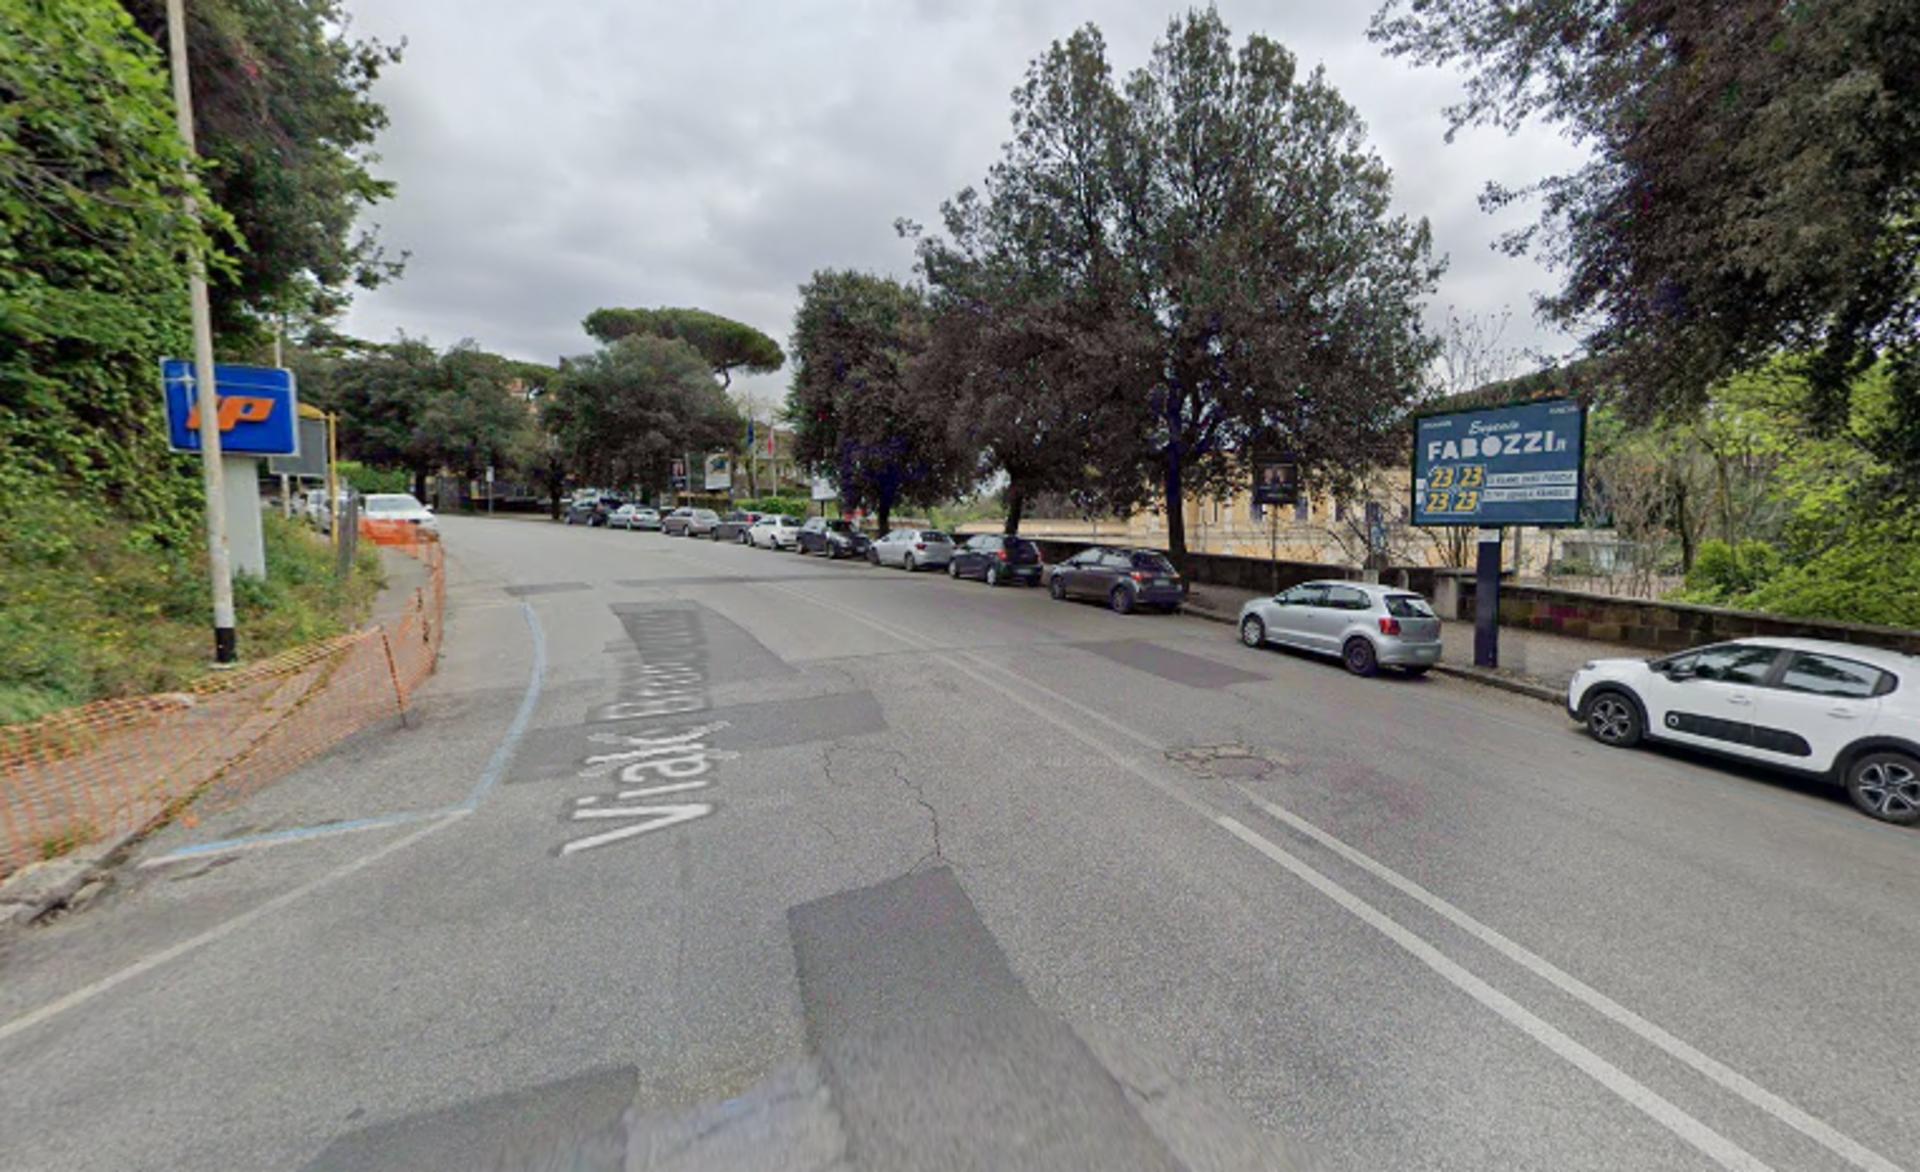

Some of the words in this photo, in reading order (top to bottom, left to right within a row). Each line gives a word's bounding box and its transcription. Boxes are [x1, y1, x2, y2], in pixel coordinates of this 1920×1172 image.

[1431, 467, 1453, 488] 23
[1460, 466, 1483, 487] 23
[1426, 492, 1449, 512] 23
[1454, 491, 1478, 511] 23
